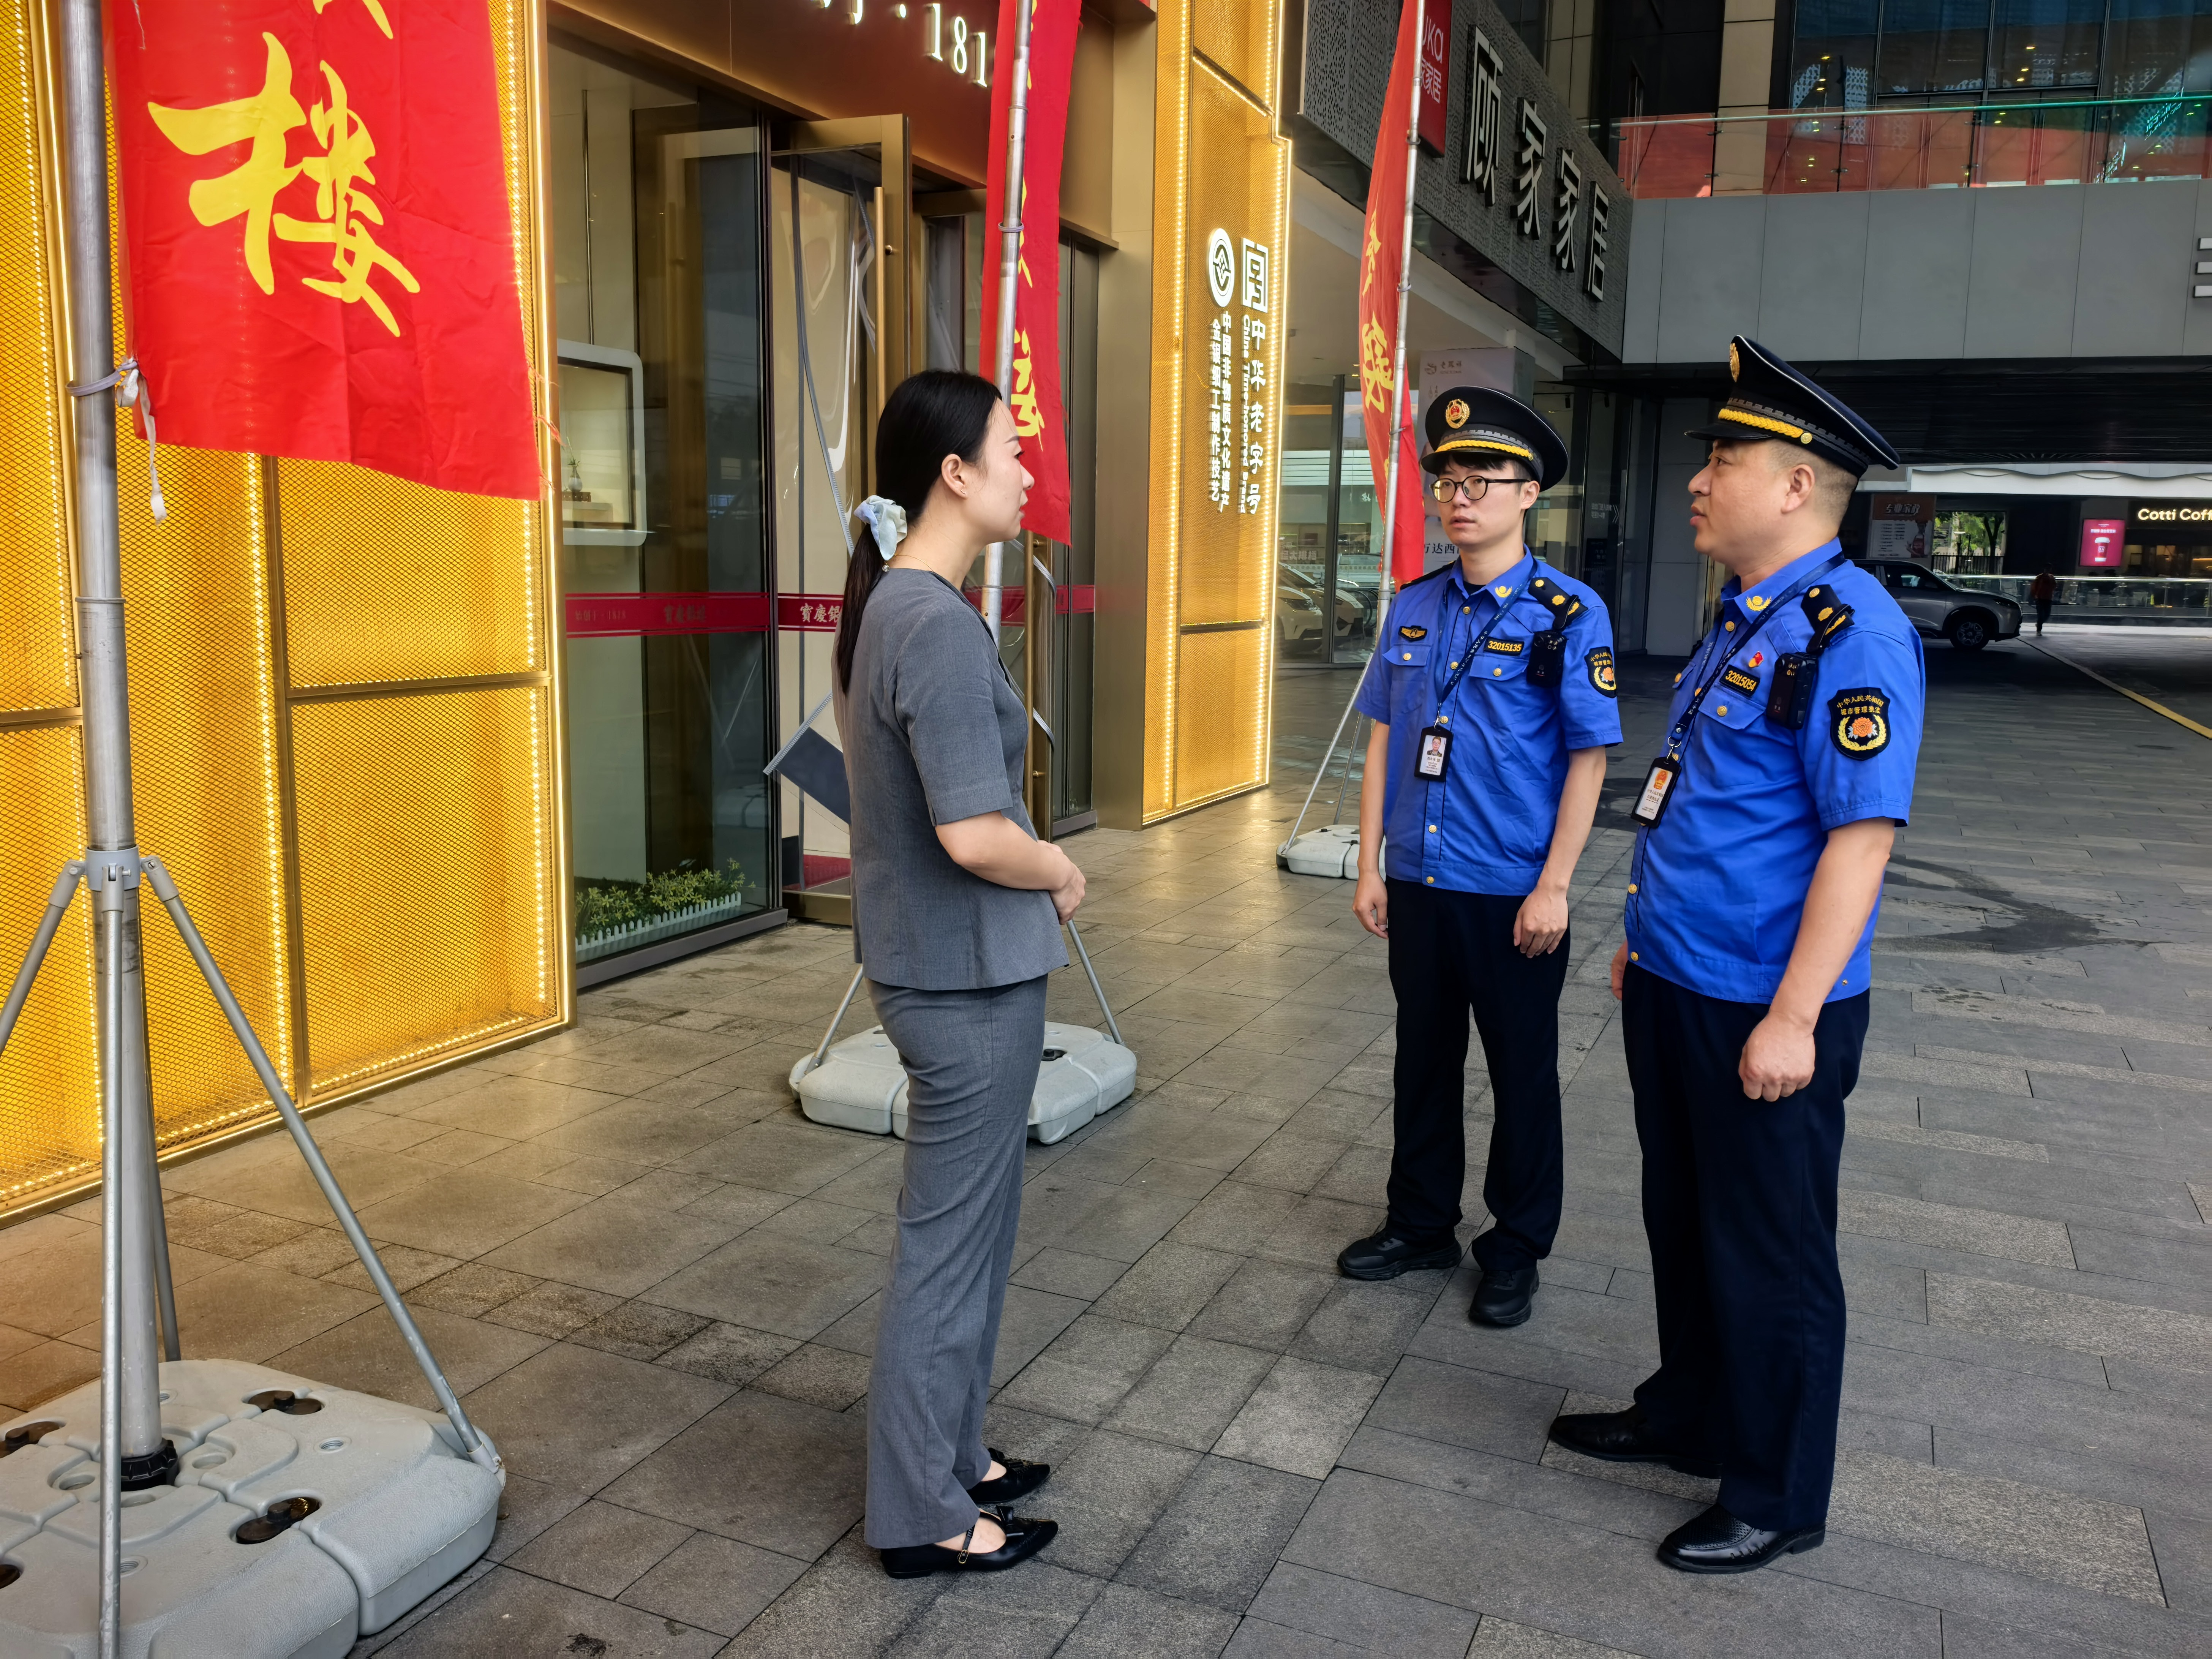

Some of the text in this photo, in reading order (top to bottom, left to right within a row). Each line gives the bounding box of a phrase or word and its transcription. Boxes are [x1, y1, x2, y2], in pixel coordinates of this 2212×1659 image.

[1466, 25, 1609, 302] 顾家家居
[1211, 318, 1221, 501] 金银细工制作技艺
[1220, 311, 1231, 513] 中国非物质文化遗产
[1247, 319, 1266, 514] 中华老字号
[2138, 509, 2176, 520] Cotti
[1424, 543, 1460, 554] 万达西
[1488, 641, 1522, 652] 32015135
[1725, 670, 1757, 691] 32015054
[1837, 695, 1884, 708] 中华人民共和国
[1841, 705, 1881, 716] 城市管理执法
